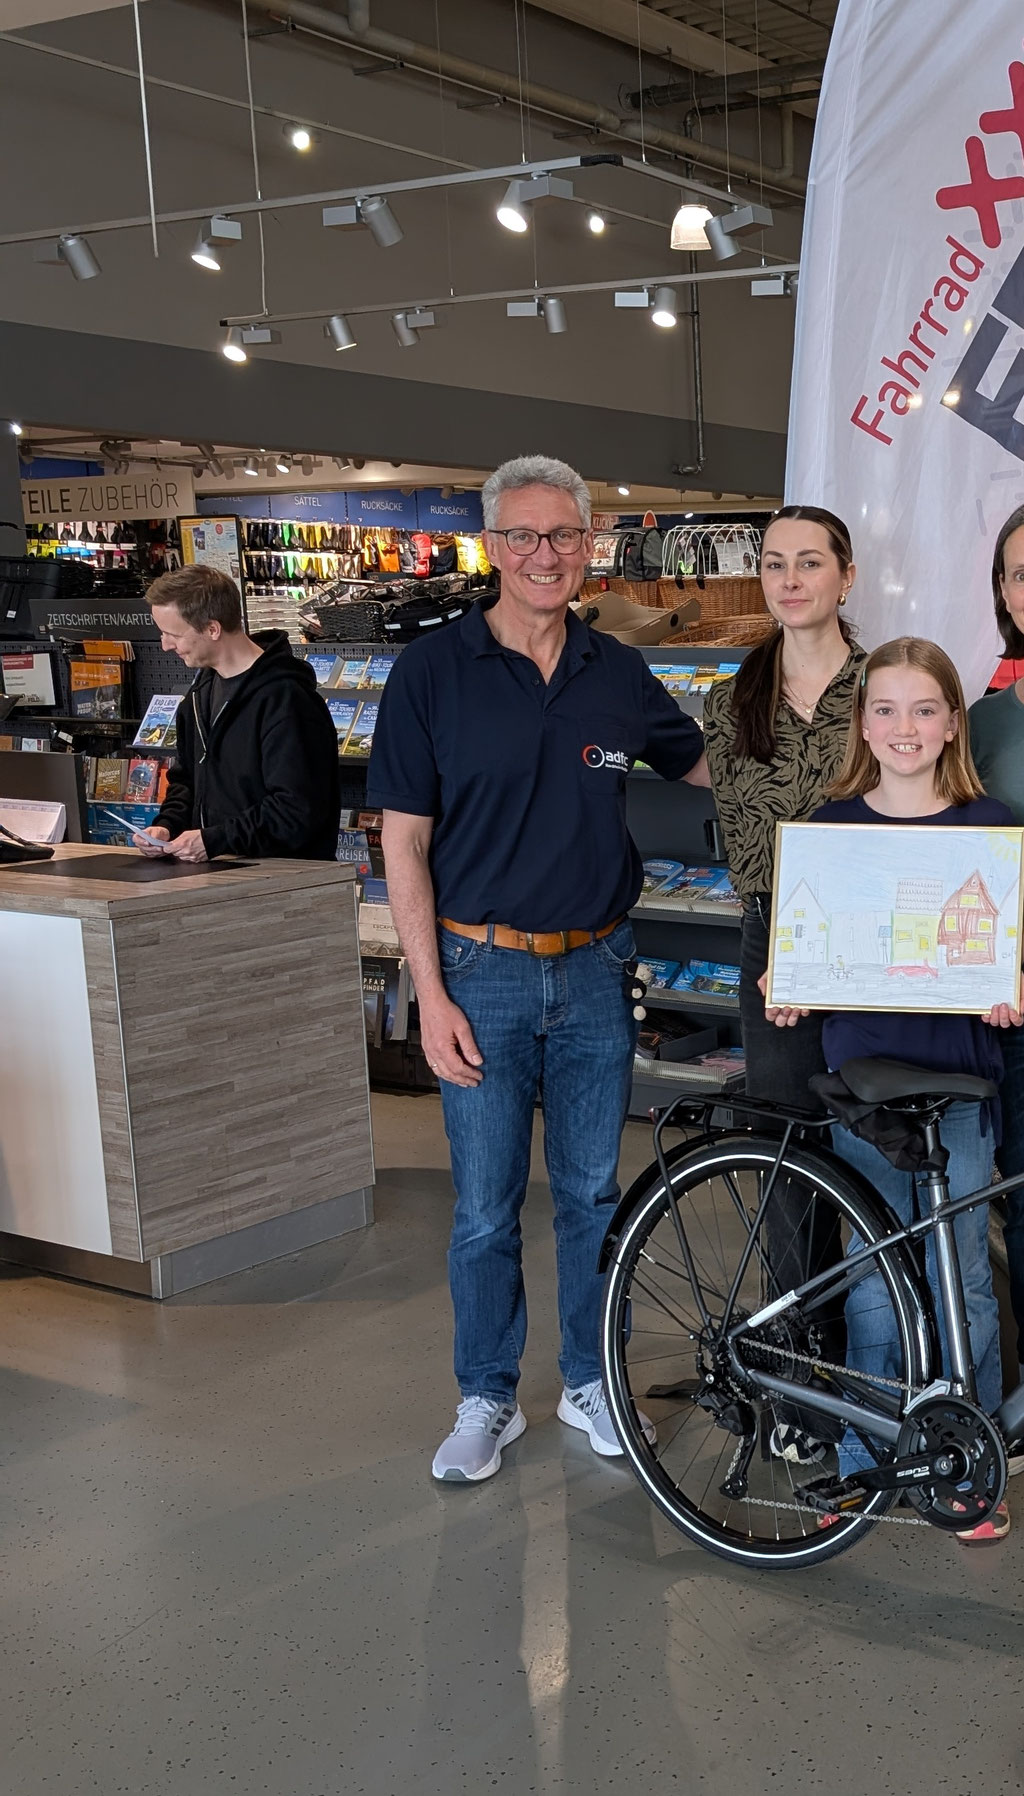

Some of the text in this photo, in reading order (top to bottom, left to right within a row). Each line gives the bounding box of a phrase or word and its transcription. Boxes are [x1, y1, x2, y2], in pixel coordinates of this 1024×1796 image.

[850, 235, 985, 446] Fahrrad
[78, 479, 179, 512] ZUBEHÖR
[294, 496, 322, 507] SATTEL
[605, 751, 629, 766] adfc
[337, 833, 355, 846] RAD
[340, 849, 369, 862] REISEN
